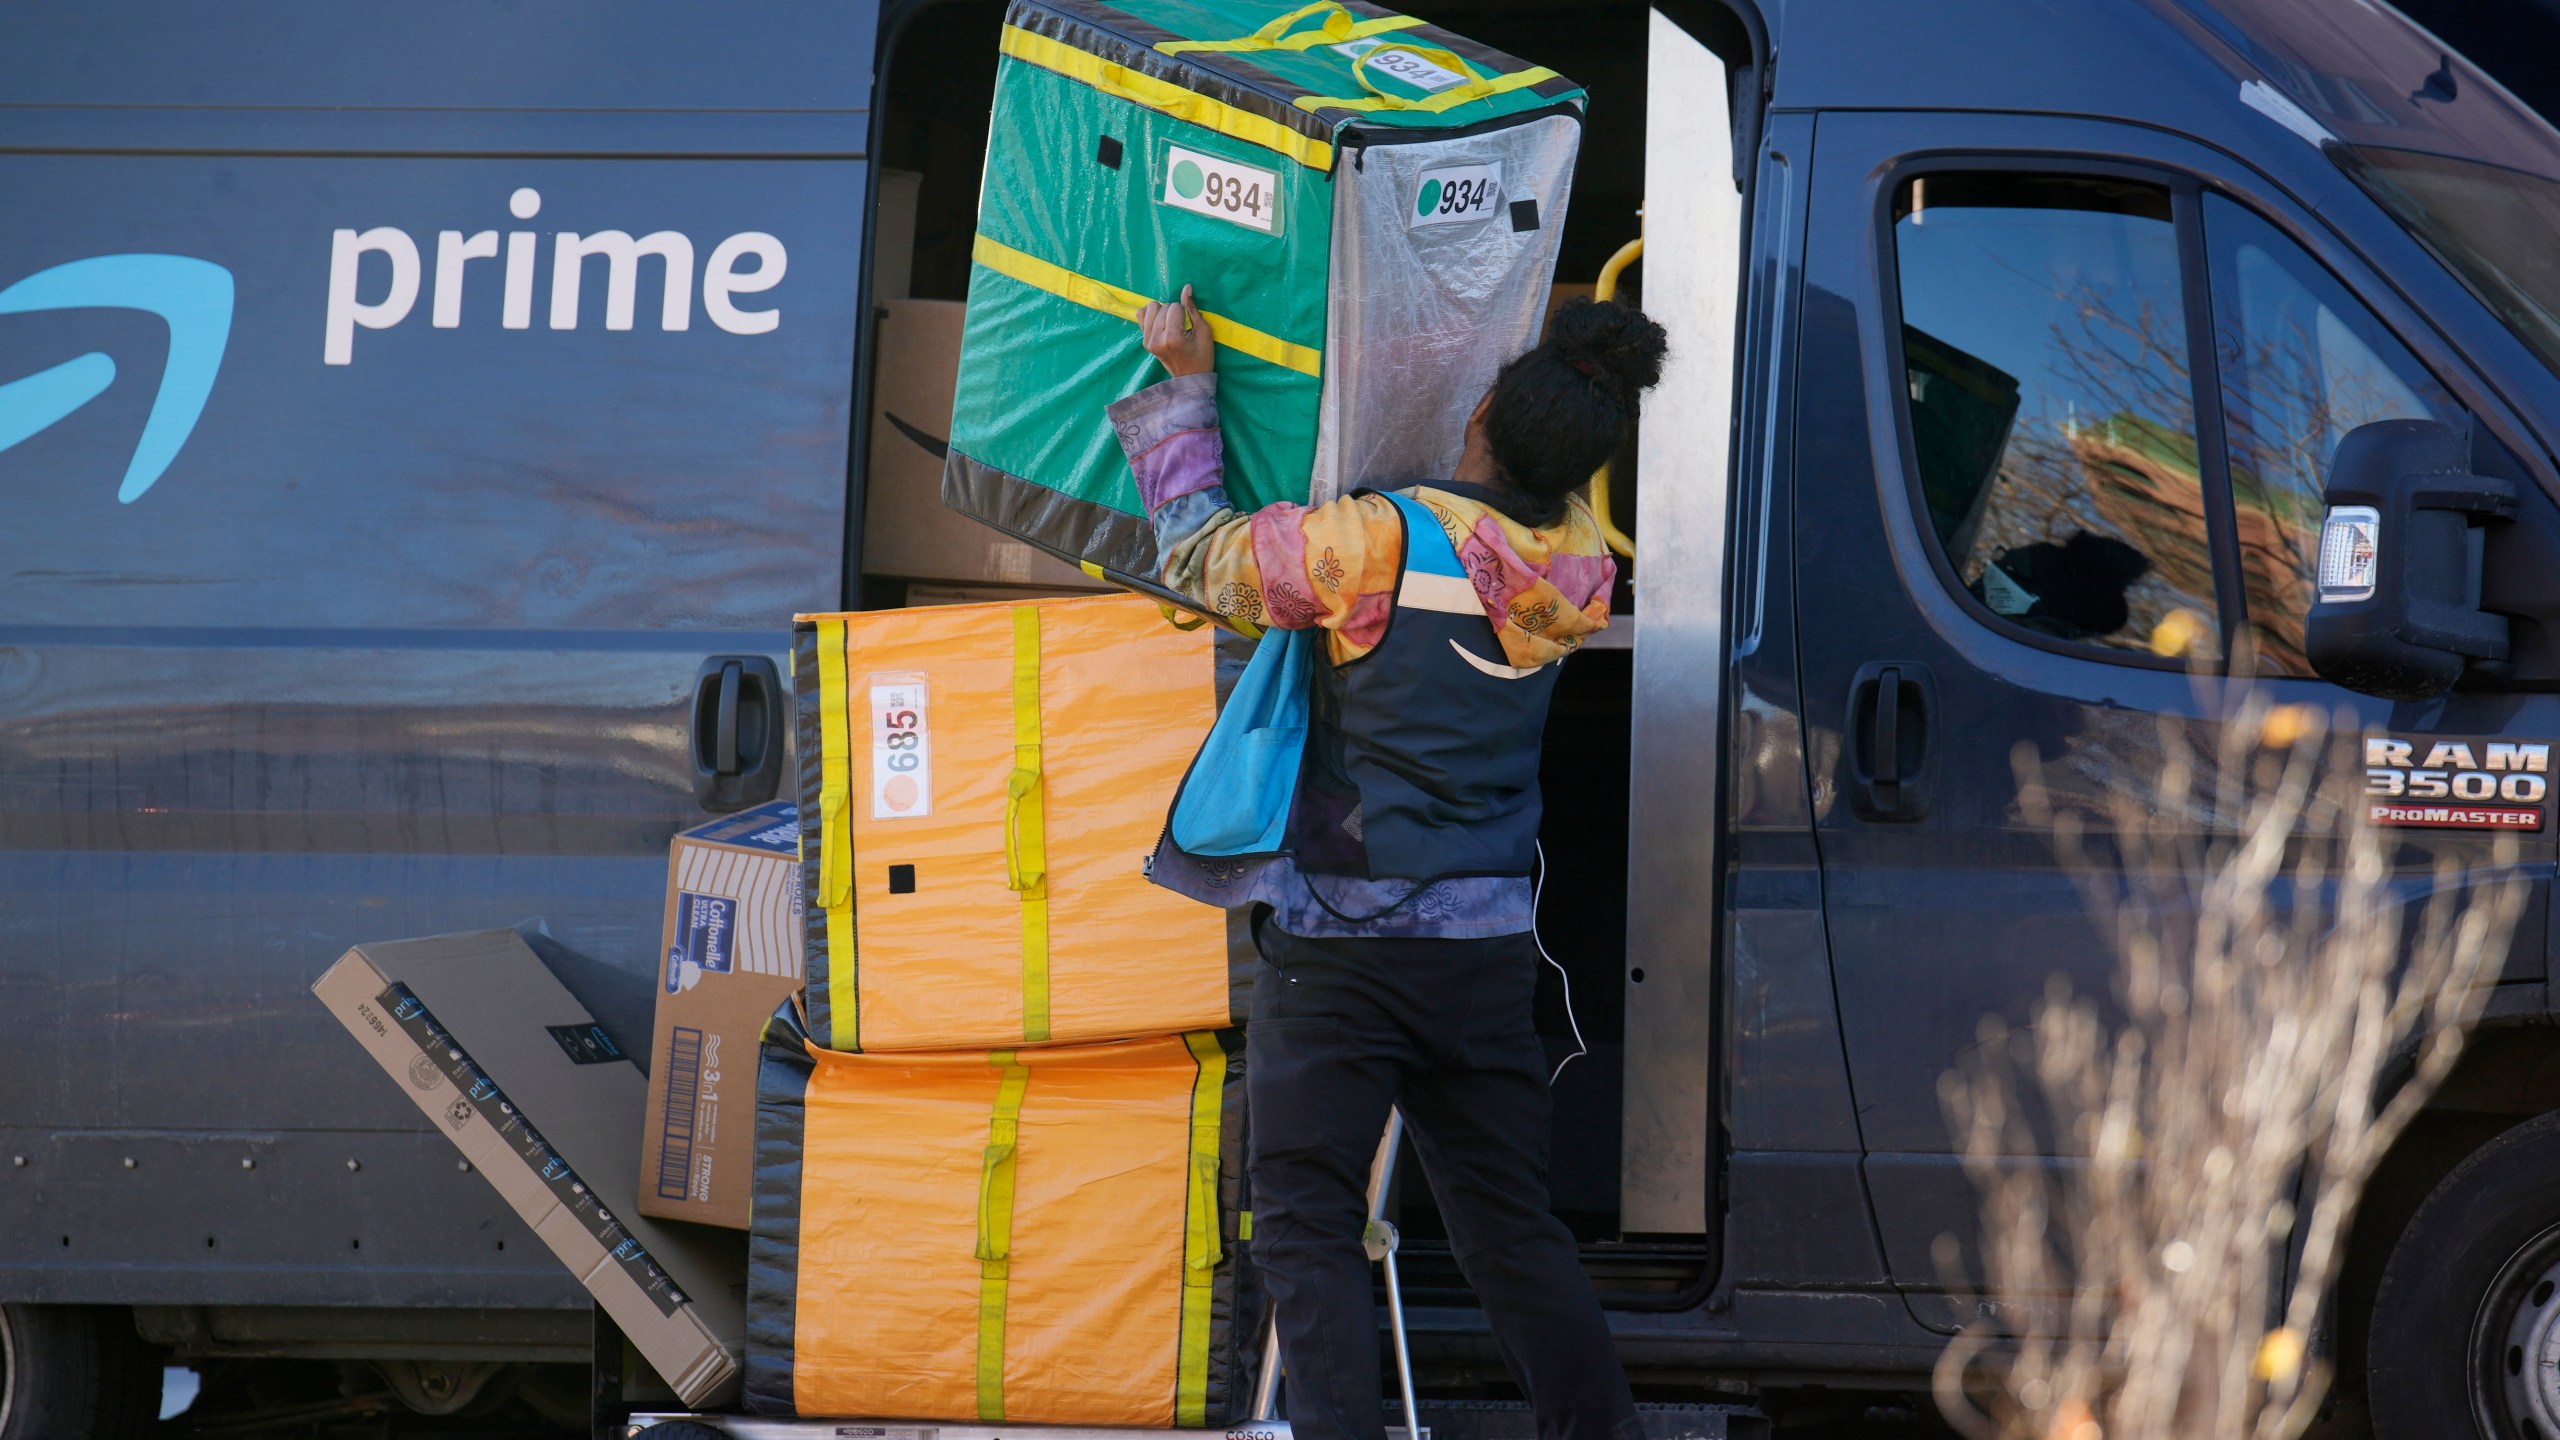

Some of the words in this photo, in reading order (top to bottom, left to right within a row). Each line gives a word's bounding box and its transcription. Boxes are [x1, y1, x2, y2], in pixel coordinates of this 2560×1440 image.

[1374, 54, 1437, 80] 934
[1206, 172, 1260, 217] 934
[1440, 178, 1488, 214] 934
[324, 187, 788, 365] prime
[886, 710, 919, 772] 685
[2366, 738, 2550, 772] RAM
[2364, 769, 2548, 803] 3500
[691, 899, 700, 928] CLEAN
[700, 900, 708, 927] ULTRA
[705, 900, 725, 968] Cottonelle
[700, 1154, 712, 1202] STRONG
[1226, 1431, 1274, 1440] COSCO
